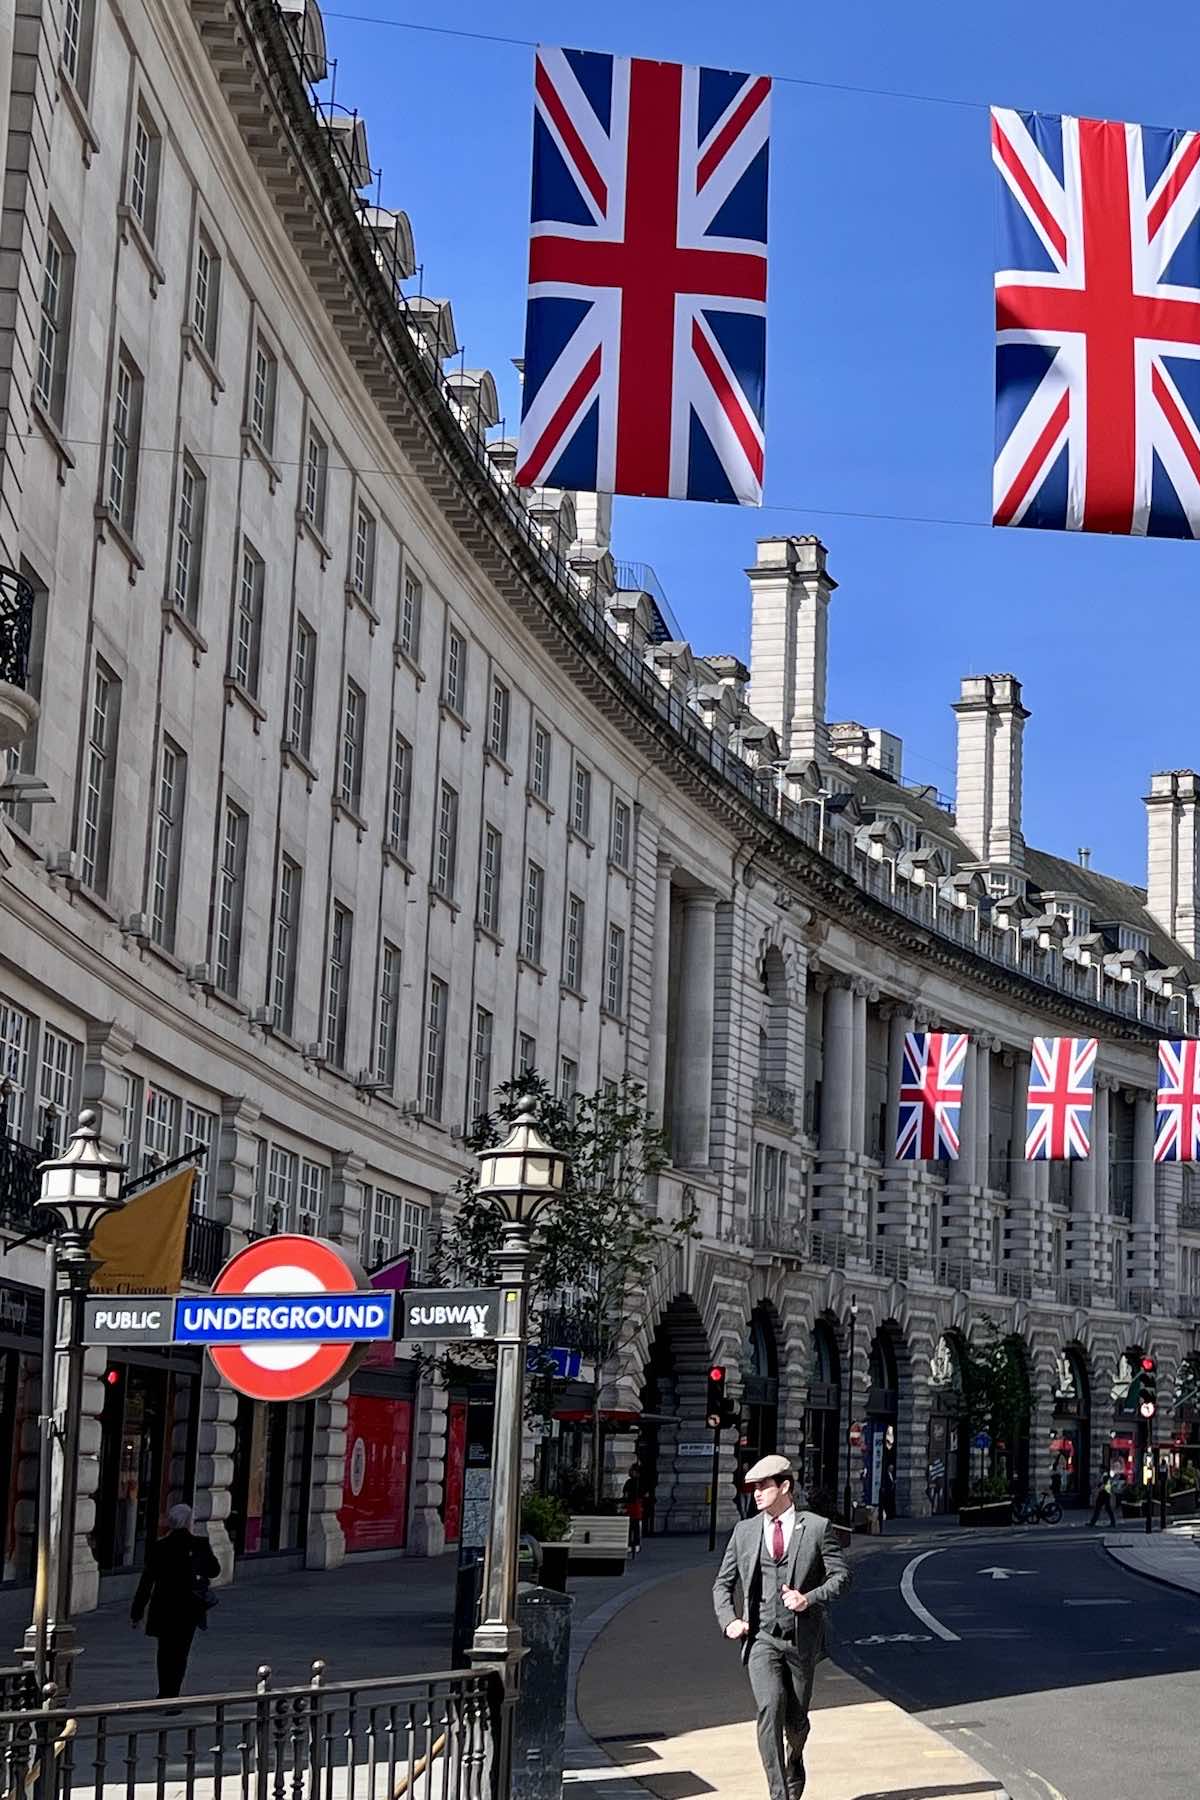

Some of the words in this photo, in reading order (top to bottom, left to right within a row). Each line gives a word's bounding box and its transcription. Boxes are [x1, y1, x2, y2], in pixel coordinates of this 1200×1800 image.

[95, 1311, 161, 1330] PUBLIC
[184, 1305, 384, 1331] UNDERGROUND
[409, 1304, 490, 1325] SUBWAY
